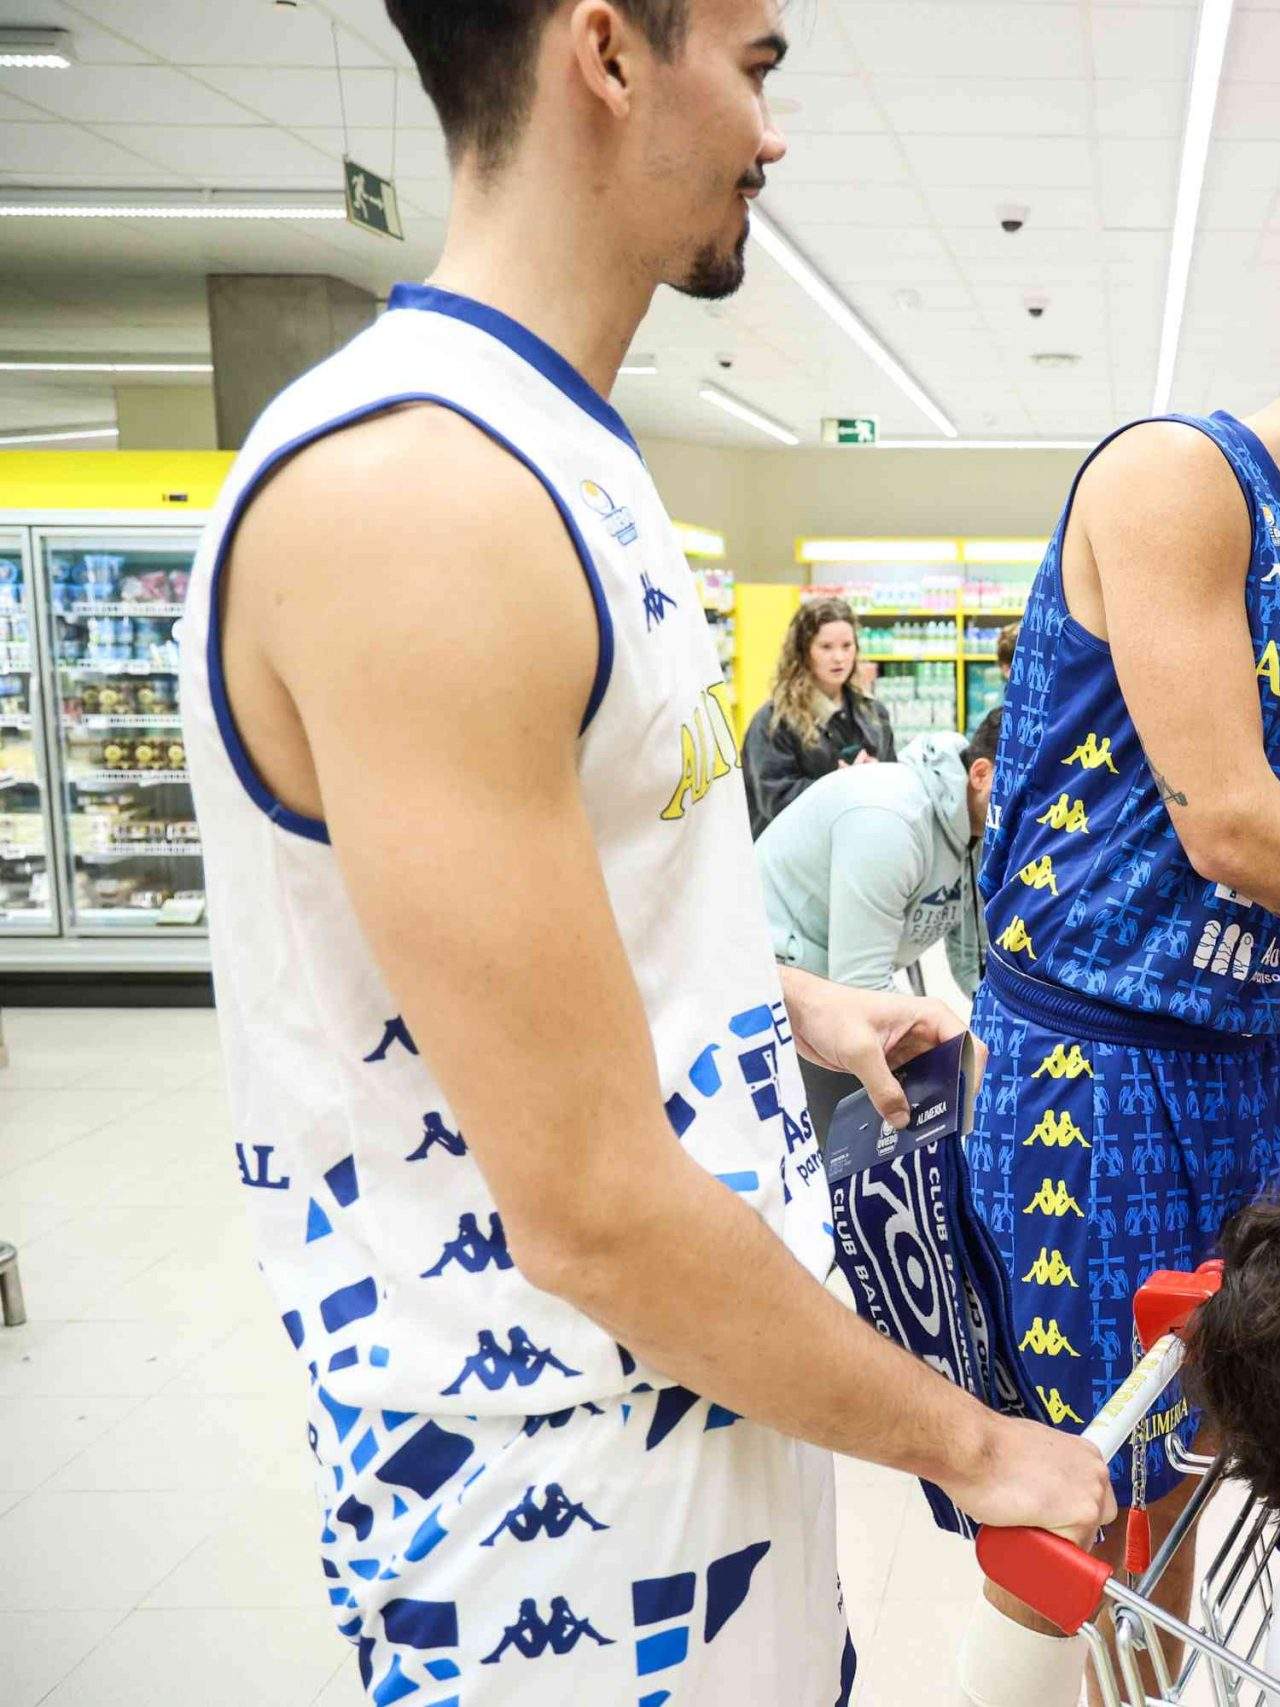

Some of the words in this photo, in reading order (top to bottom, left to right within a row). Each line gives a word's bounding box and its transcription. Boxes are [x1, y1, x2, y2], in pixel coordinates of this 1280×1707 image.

[928, 1166, 949, 1242] CLUB
[834, 1187, 858, 1256] CLUB
[853, 1264, 893, 1338] BALO
